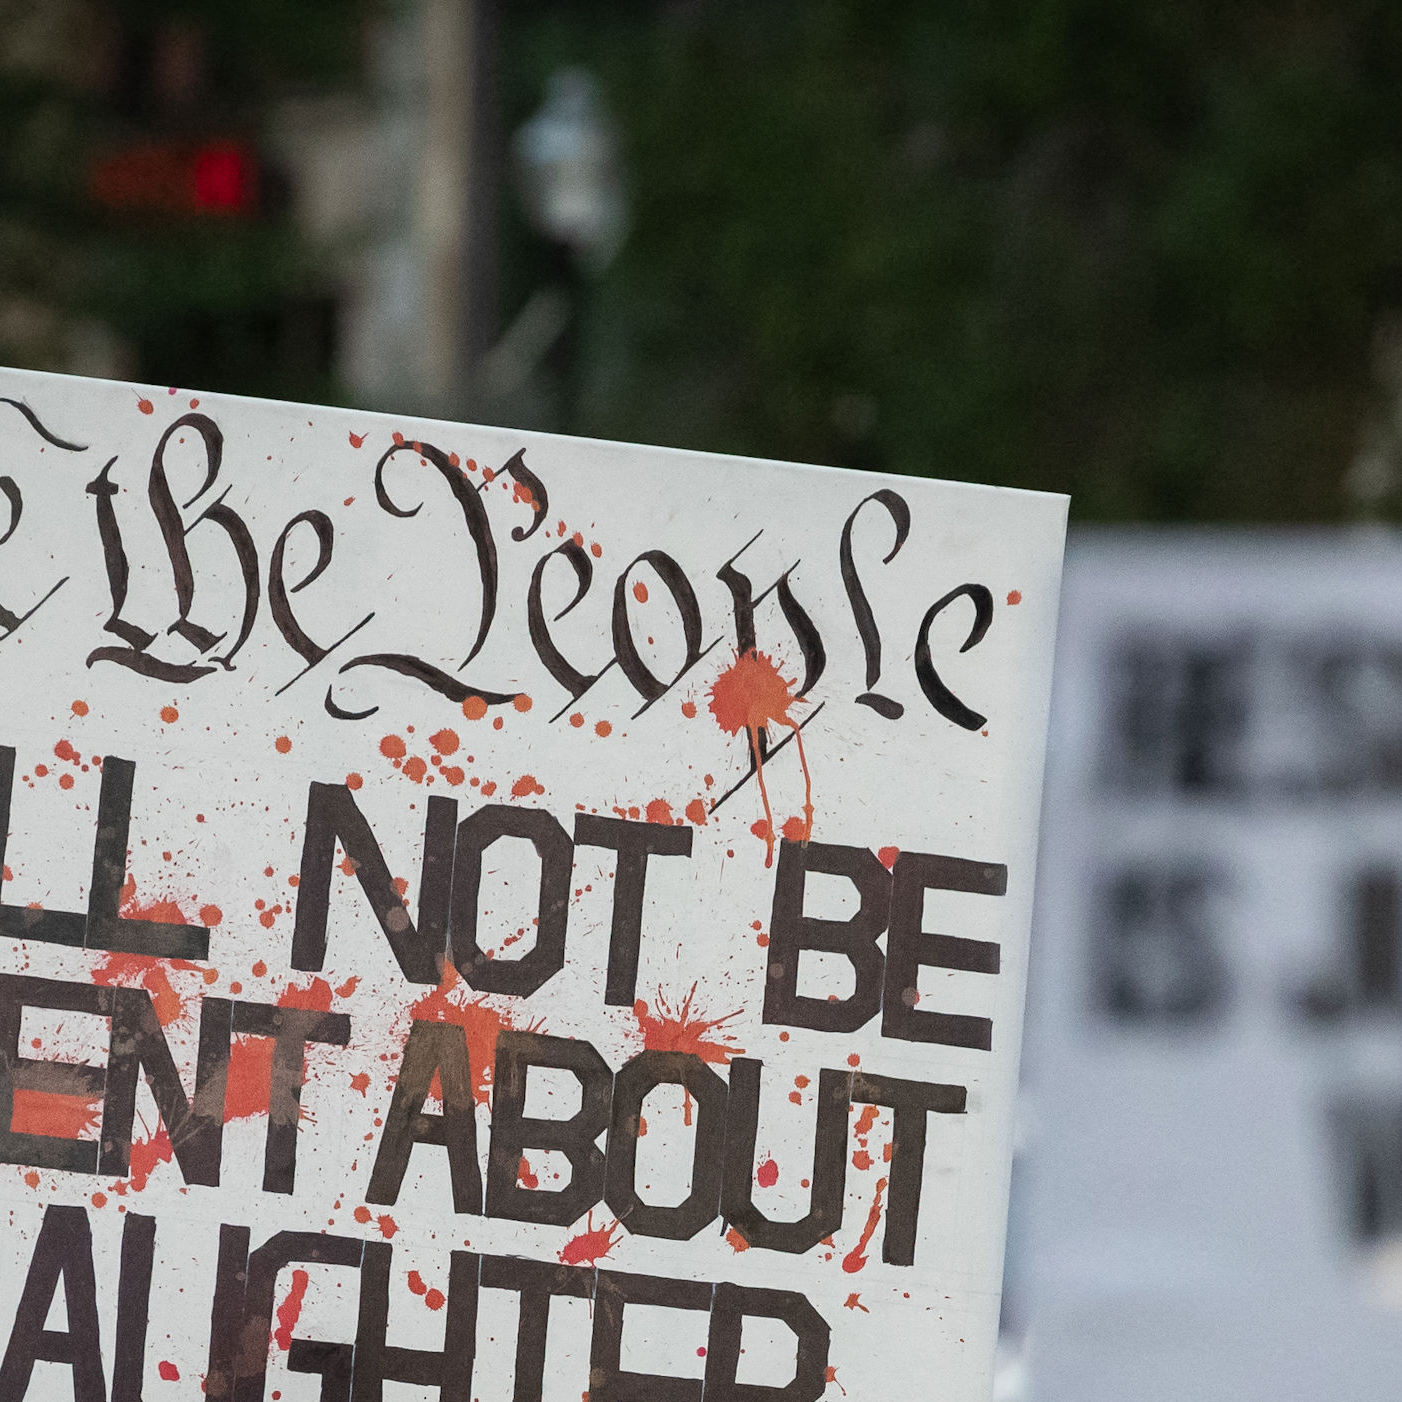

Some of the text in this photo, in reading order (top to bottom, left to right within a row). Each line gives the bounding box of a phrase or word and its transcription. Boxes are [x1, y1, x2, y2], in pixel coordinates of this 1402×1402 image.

[323, 437, 994, 813] People
[291, 780, 692, 1007] NOT
[762, 838, 1007, 1052] BE
[1084, 848, 1233, 1028] IS
[367, 1012, 967, 1266] ABOUT
